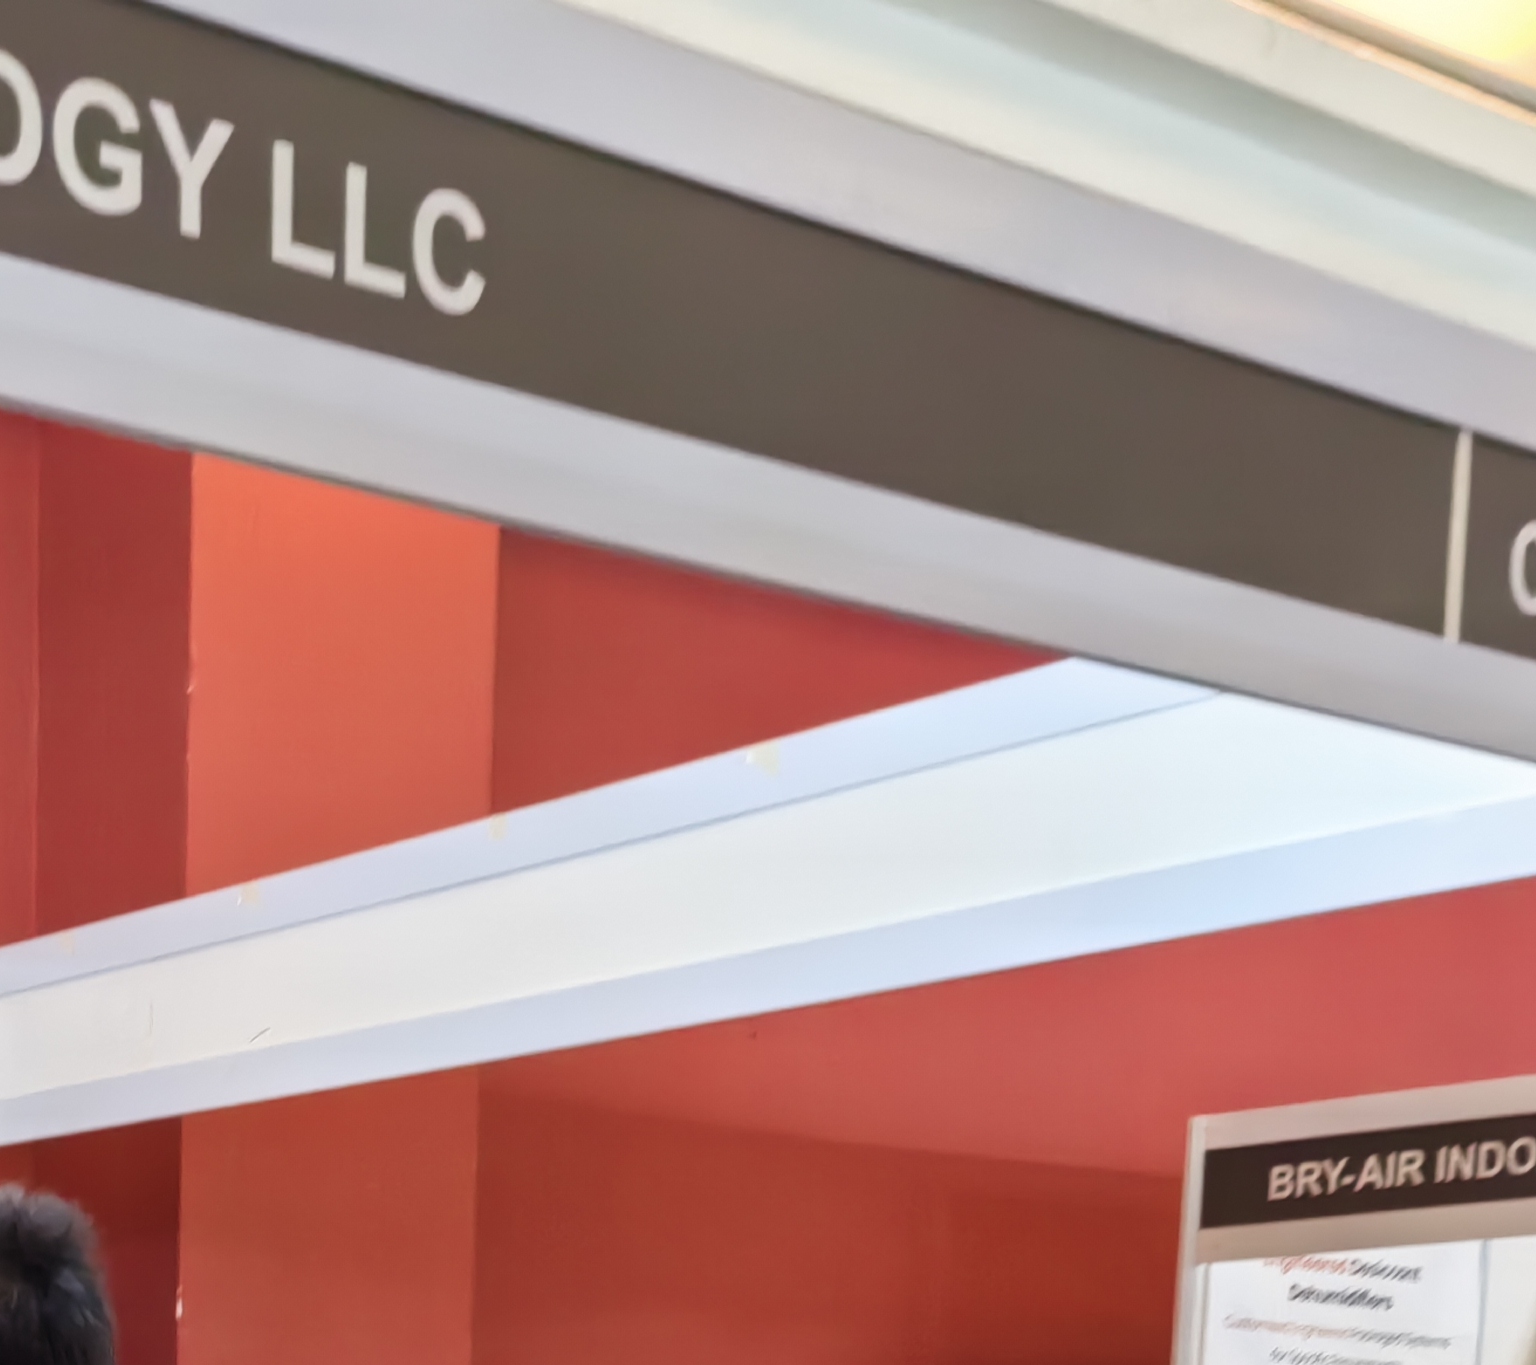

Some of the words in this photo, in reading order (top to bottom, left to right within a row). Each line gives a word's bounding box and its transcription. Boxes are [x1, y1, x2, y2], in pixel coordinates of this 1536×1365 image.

[270, 139, 486, 317] LLC
[1267, 1149, 1426, 1202] BRY-AIR
[1434, 1136, 1536, 1185] INDO
